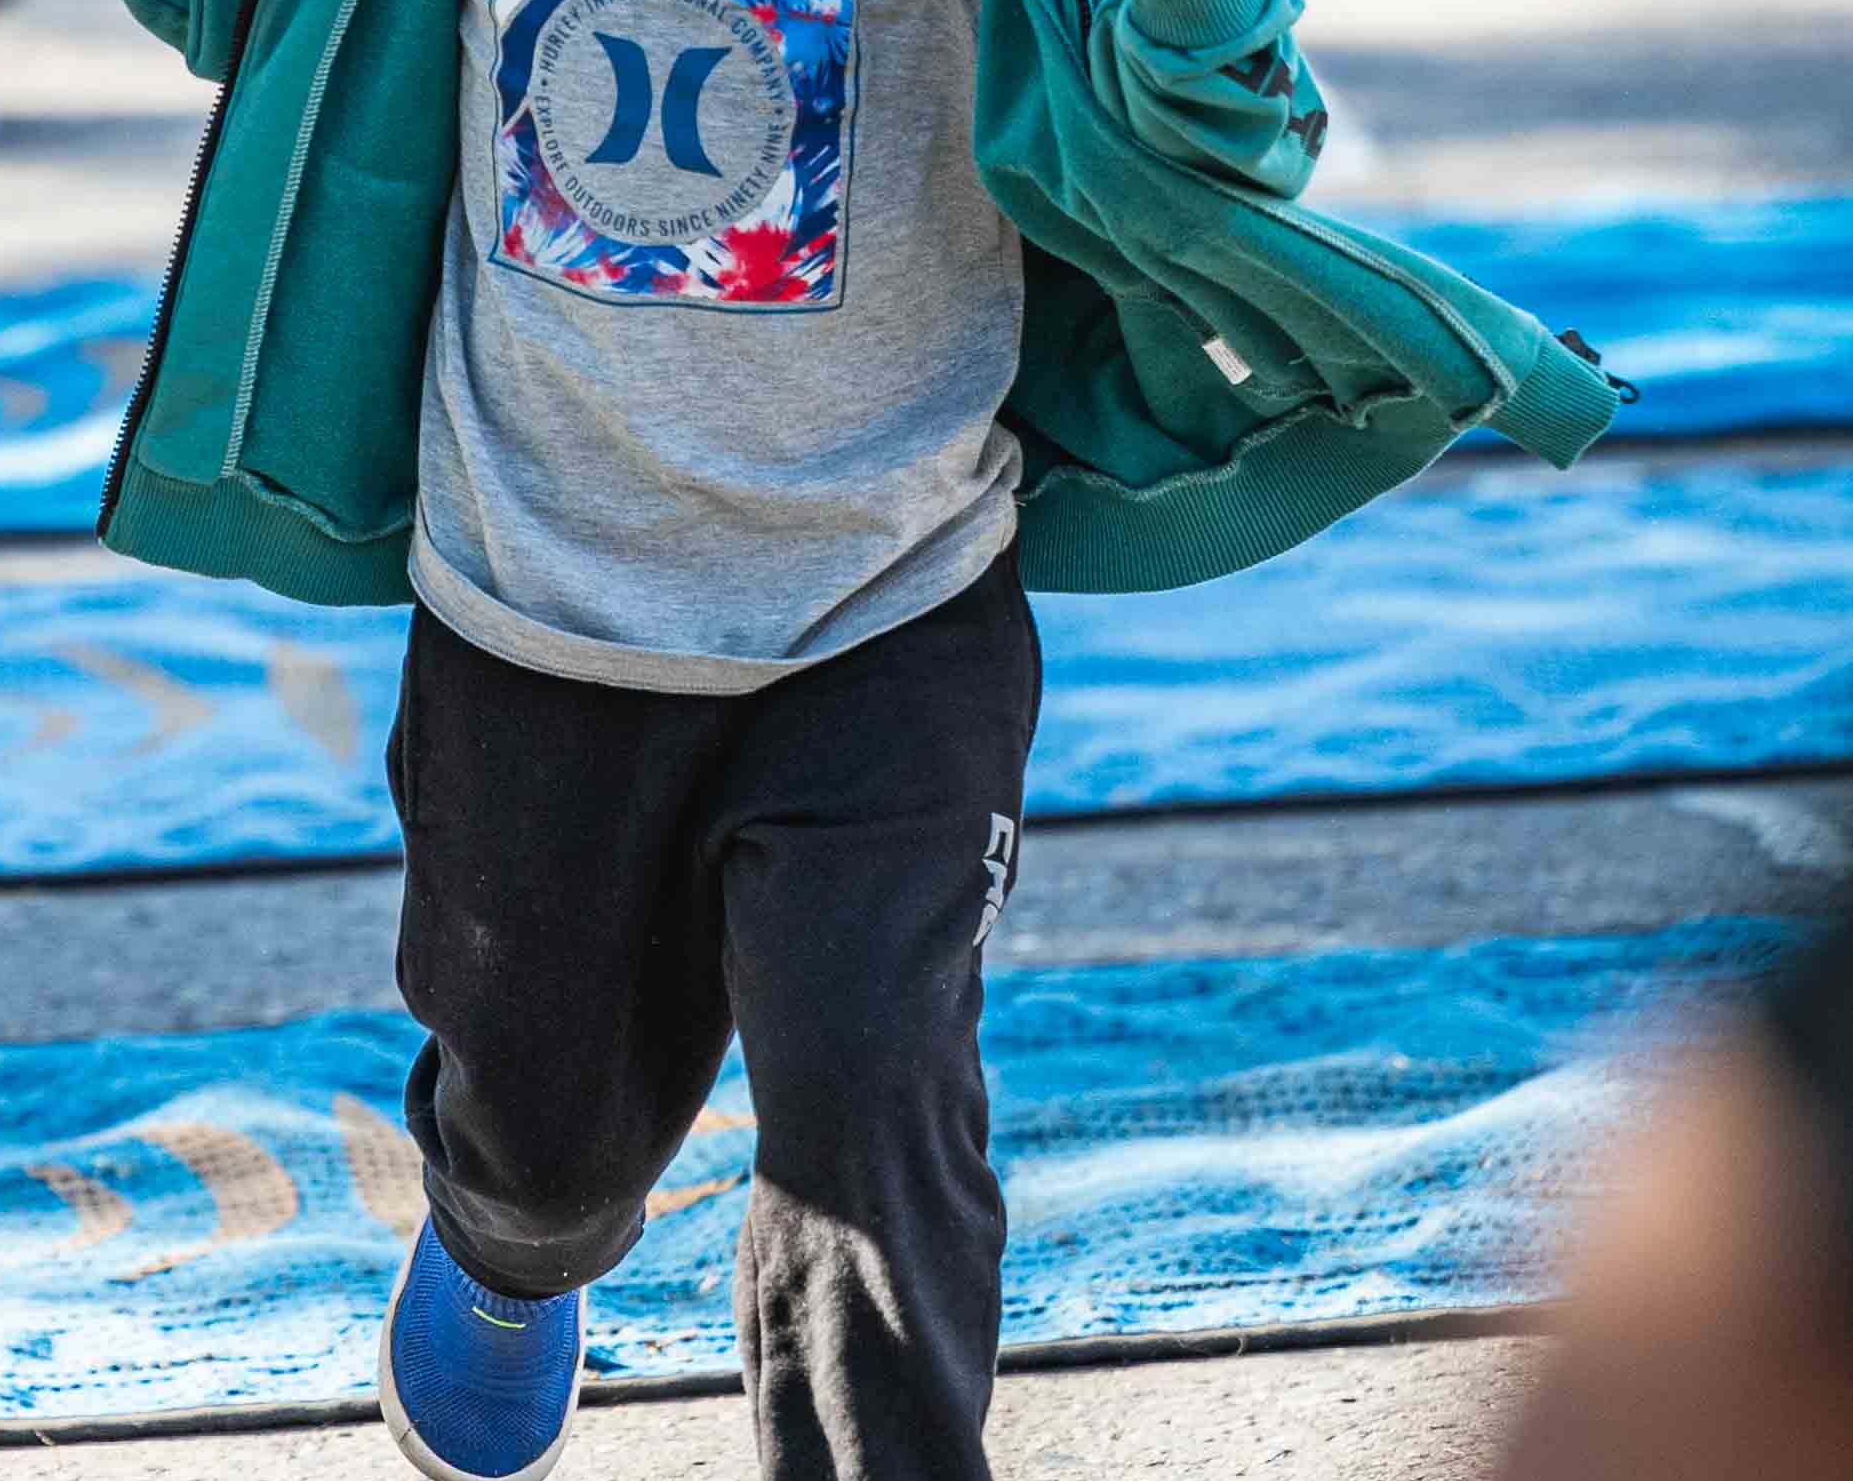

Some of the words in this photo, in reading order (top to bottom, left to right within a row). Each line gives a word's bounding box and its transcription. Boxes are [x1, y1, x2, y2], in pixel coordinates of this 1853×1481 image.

[539, 4, 581, 74] HURLEY
[731, 17, 786, 104] COMPANY
[535, 95, 569, 172] EXPLORE
[565, 175, 650, 237] OUTDOORS
[658, 209, 713, 237] SINCE
[714, 165, 769, 220] NINETY
[759, 123, 790, 164] NINE
